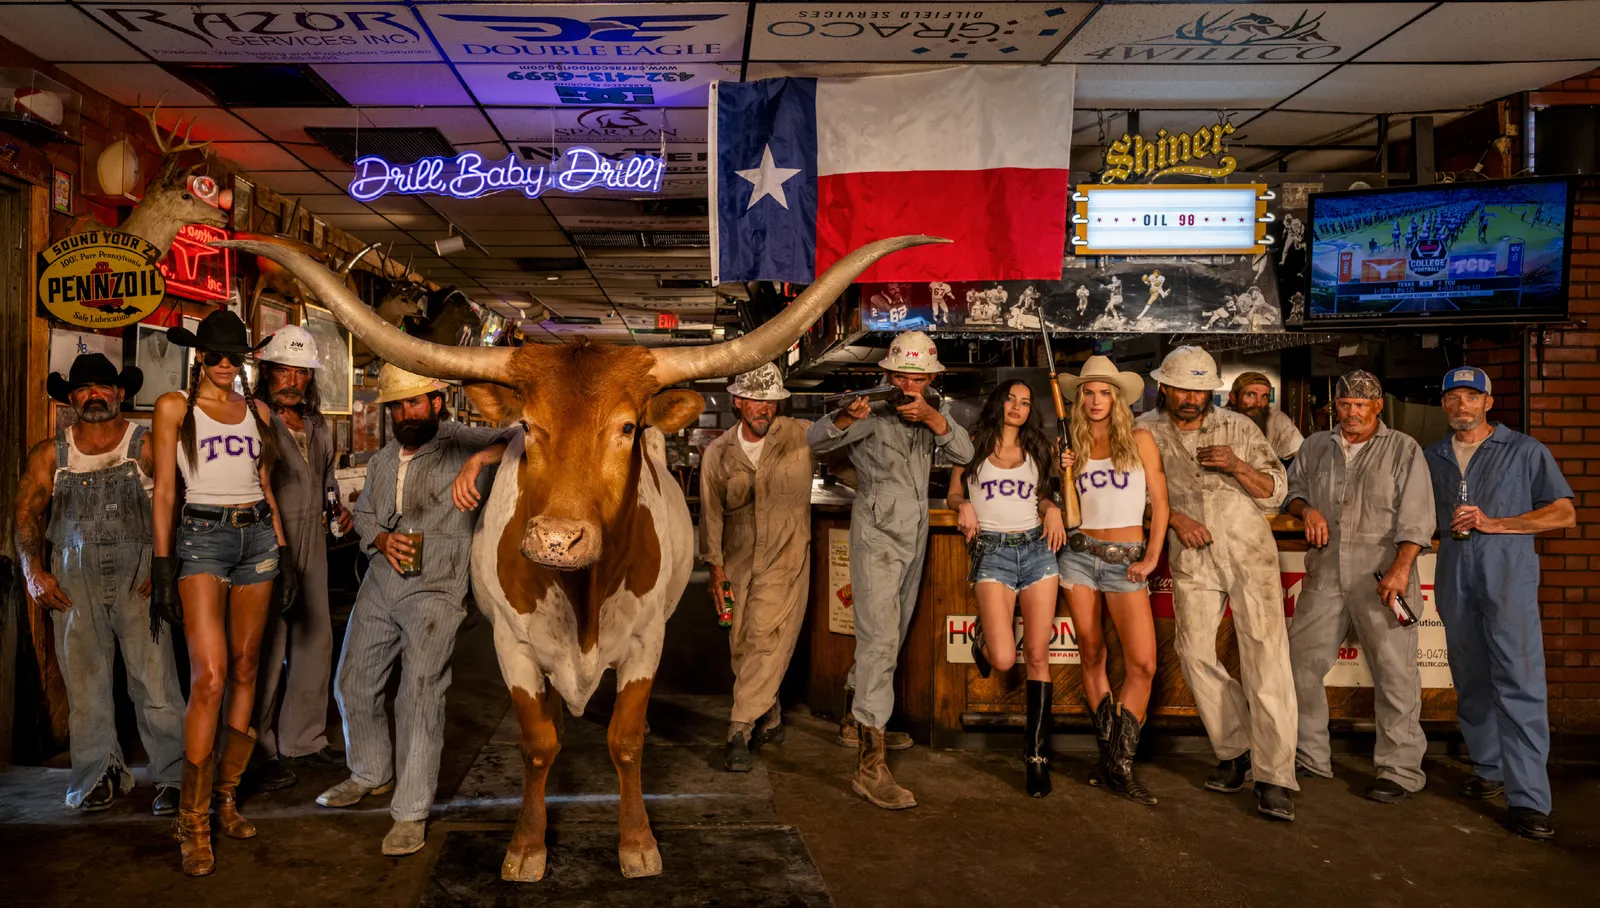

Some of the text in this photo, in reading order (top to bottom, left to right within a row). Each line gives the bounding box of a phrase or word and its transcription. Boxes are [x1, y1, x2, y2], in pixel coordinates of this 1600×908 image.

[799, 10, 984, 19] OILFIELD SERVICES
[97, 8, 420, 48] RAZOR
[767, 21, 1000, 38] GRACO
[226, 34, 417, 46] SERVICES INC.
[461, 43, 721, 57] DOUBLE EAGLE
[1083, 45, 1342, 61] 4WILLCO
[507, 71, 695, 82] 432-413-6599
[554, 128, 678, 137] SPARTAN
[1101, 122, 1237, 184] Shiner
[351, 148, 663, 199] Drill, Baby, Drill!
[1143, 214, 1195, 226] OIL 98
[52, 232, 98, 256] SOUND
[102, 232, 140, 249] YOUR
[60, 250, 142, 269] 100% Pure Pennsylvania
[1410, 258, 1445, 268] COLLEGE
[1454, 258, 1491, 274] TCU
[48, 269, 162, 303] PENNZOIL
[933, 287, 945, 297] 67
[73, 311, 131, 323] Safe Lubrication
[659, 314, 676, 329] EXIT
[199, 435, 263, 462] TCU
[981, 479, 1035, 501] TCU
[1075, 469, 1130, 495] TCU
